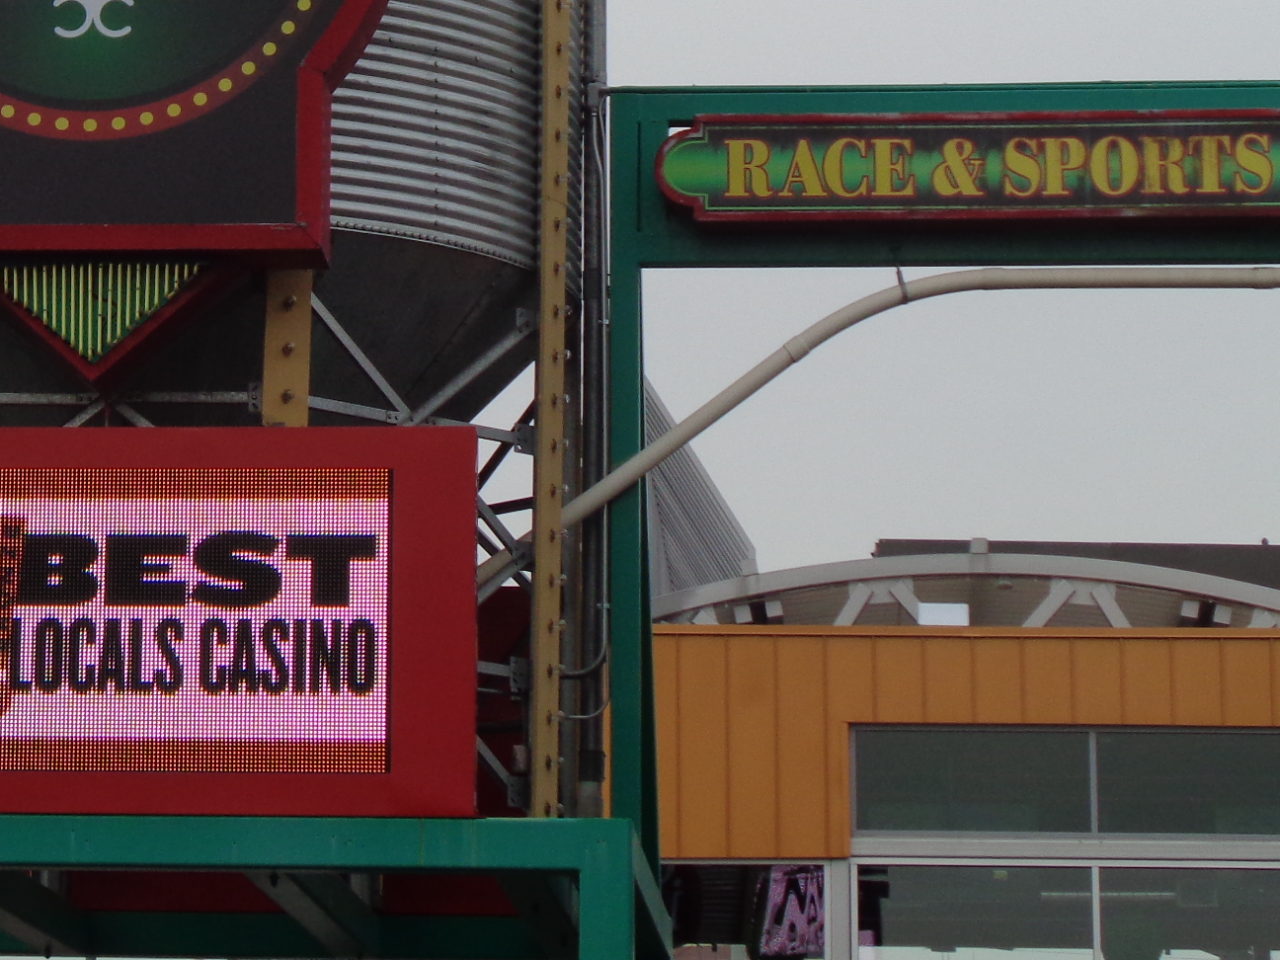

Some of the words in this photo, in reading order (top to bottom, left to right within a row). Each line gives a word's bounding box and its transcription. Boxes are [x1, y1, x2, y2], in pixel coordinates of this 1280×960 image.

[723, 137, 916, 199] RACE
[931, 136, 985, 198] &
[1002, 132, 1275, 198] SPORTS
[18, 531, 378, 608] BEST
[10, 616, 184, 696] LOCALS
[201, 616, 378, 696] CASINO
